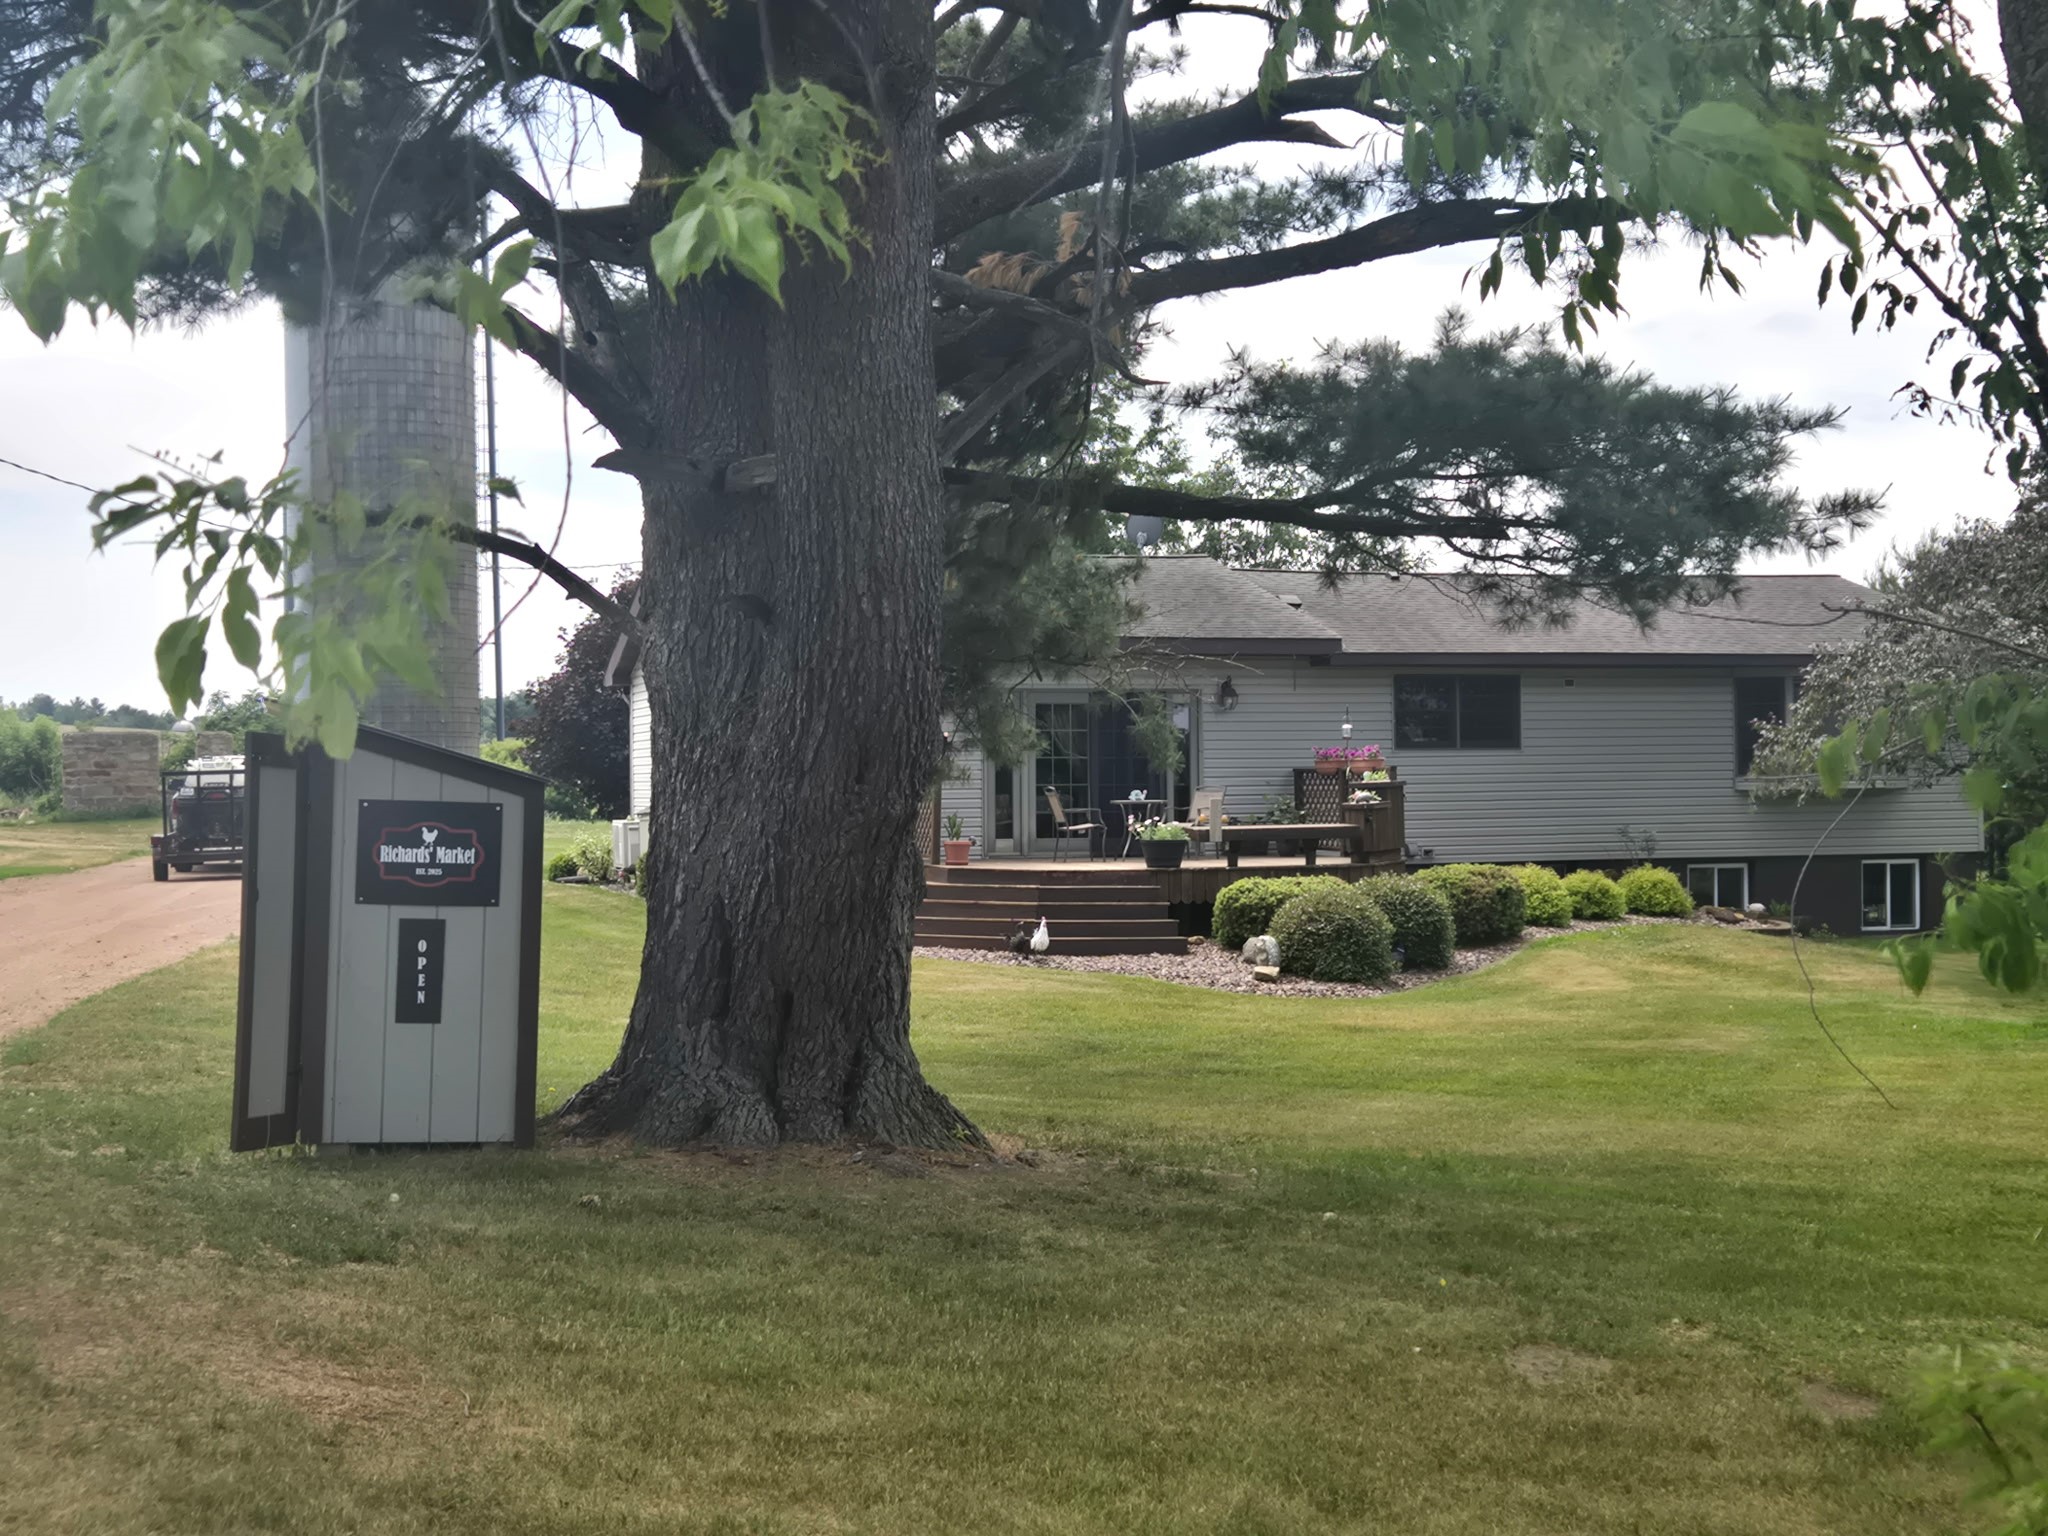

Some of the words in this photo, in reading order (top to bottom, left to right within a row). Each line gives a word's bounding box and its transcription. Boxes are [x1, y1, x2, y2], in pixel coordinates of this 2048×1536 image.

[380, 845, 433, 863] Richards'
[436, 846, 475, 864] Market
[417, 939, 427, 1004] OPEN
